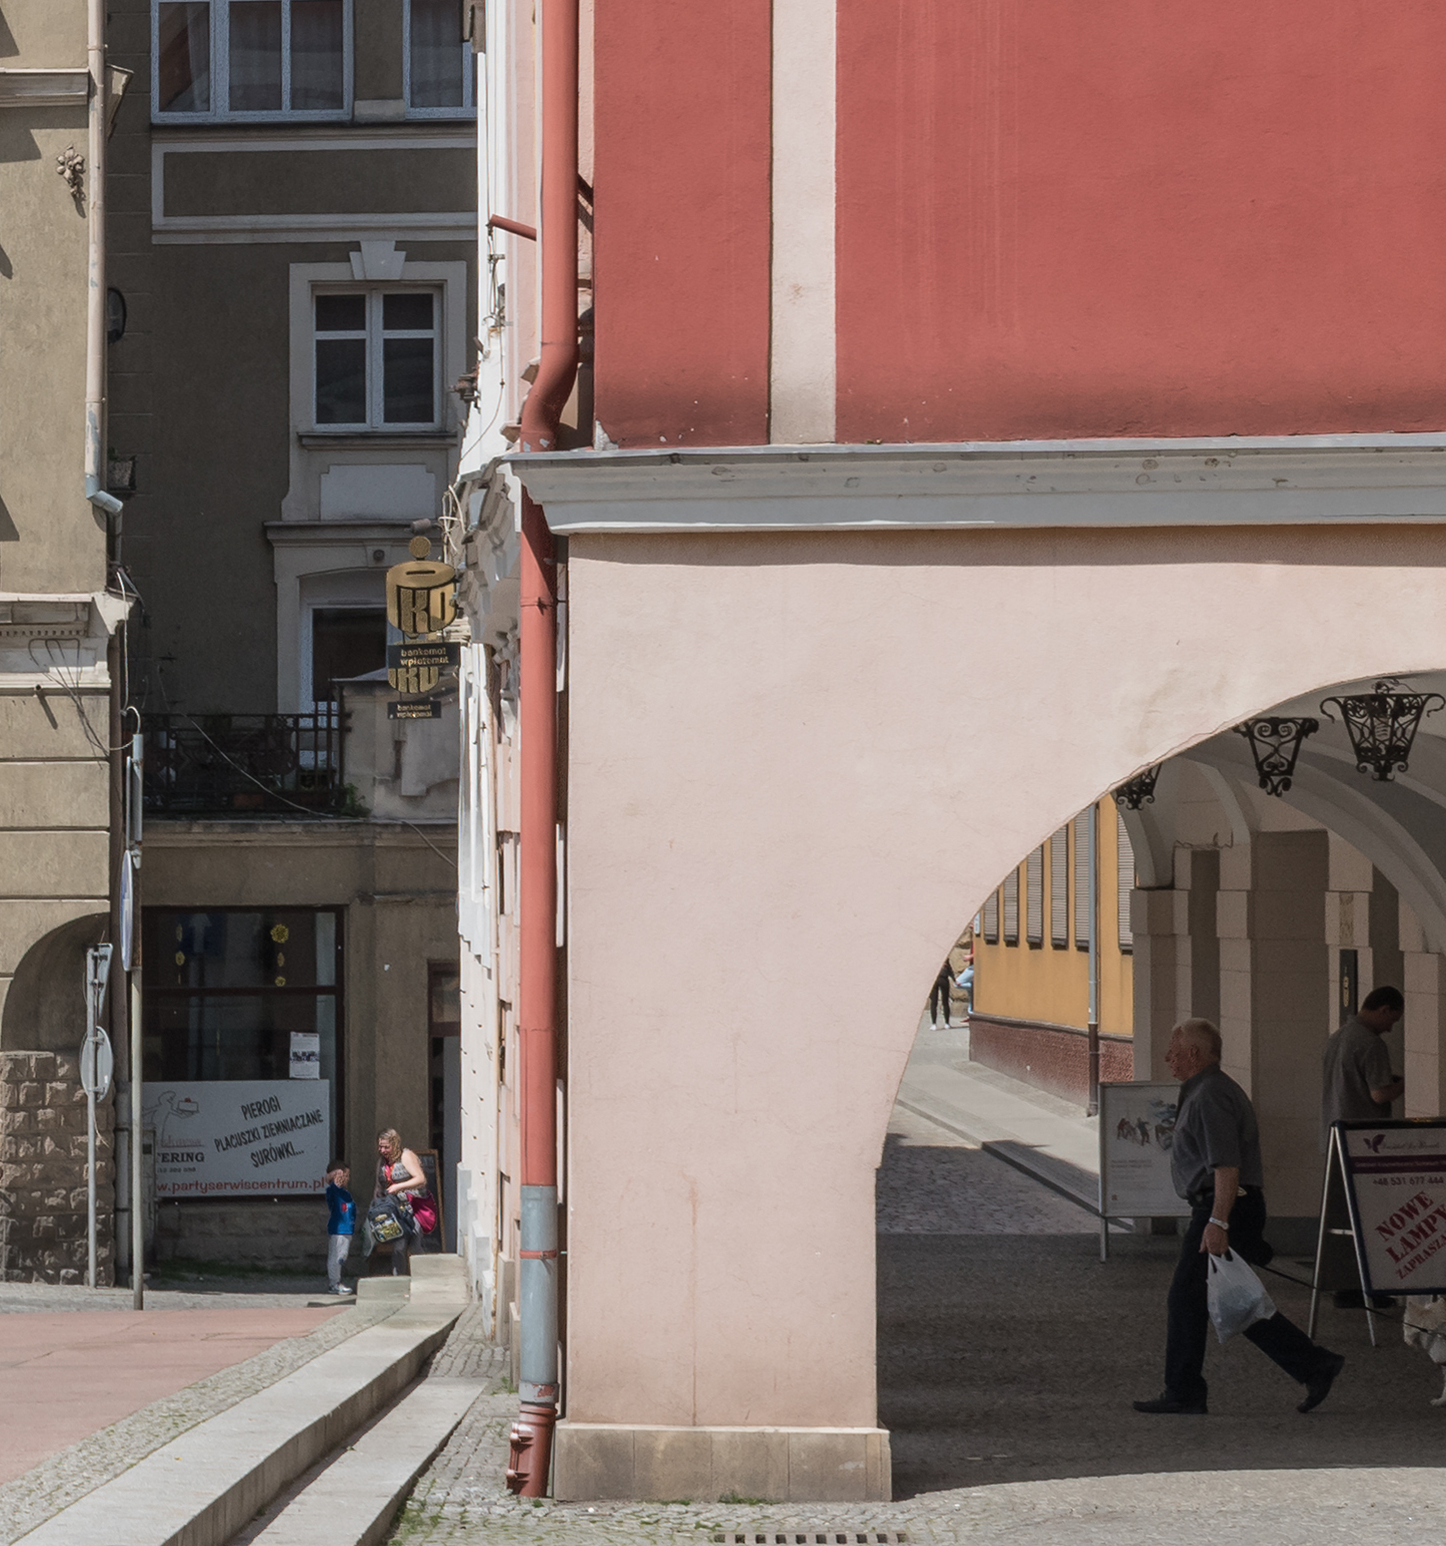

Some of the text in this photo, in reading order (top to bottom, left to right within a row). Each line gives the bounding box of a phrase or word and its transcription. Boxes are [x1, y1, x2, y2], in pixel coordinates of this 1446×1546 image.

[240, 1095, 282, 1121] PIEROGI
[214, 1127, 261, 1153] PLACUSZKI
[261, 1108, 324, 1140] ZIEMNIACZANE
[250, 1140, 305, 1168] SURÓWKI...
[1375, 1190, 1435, 1243] NOWE
